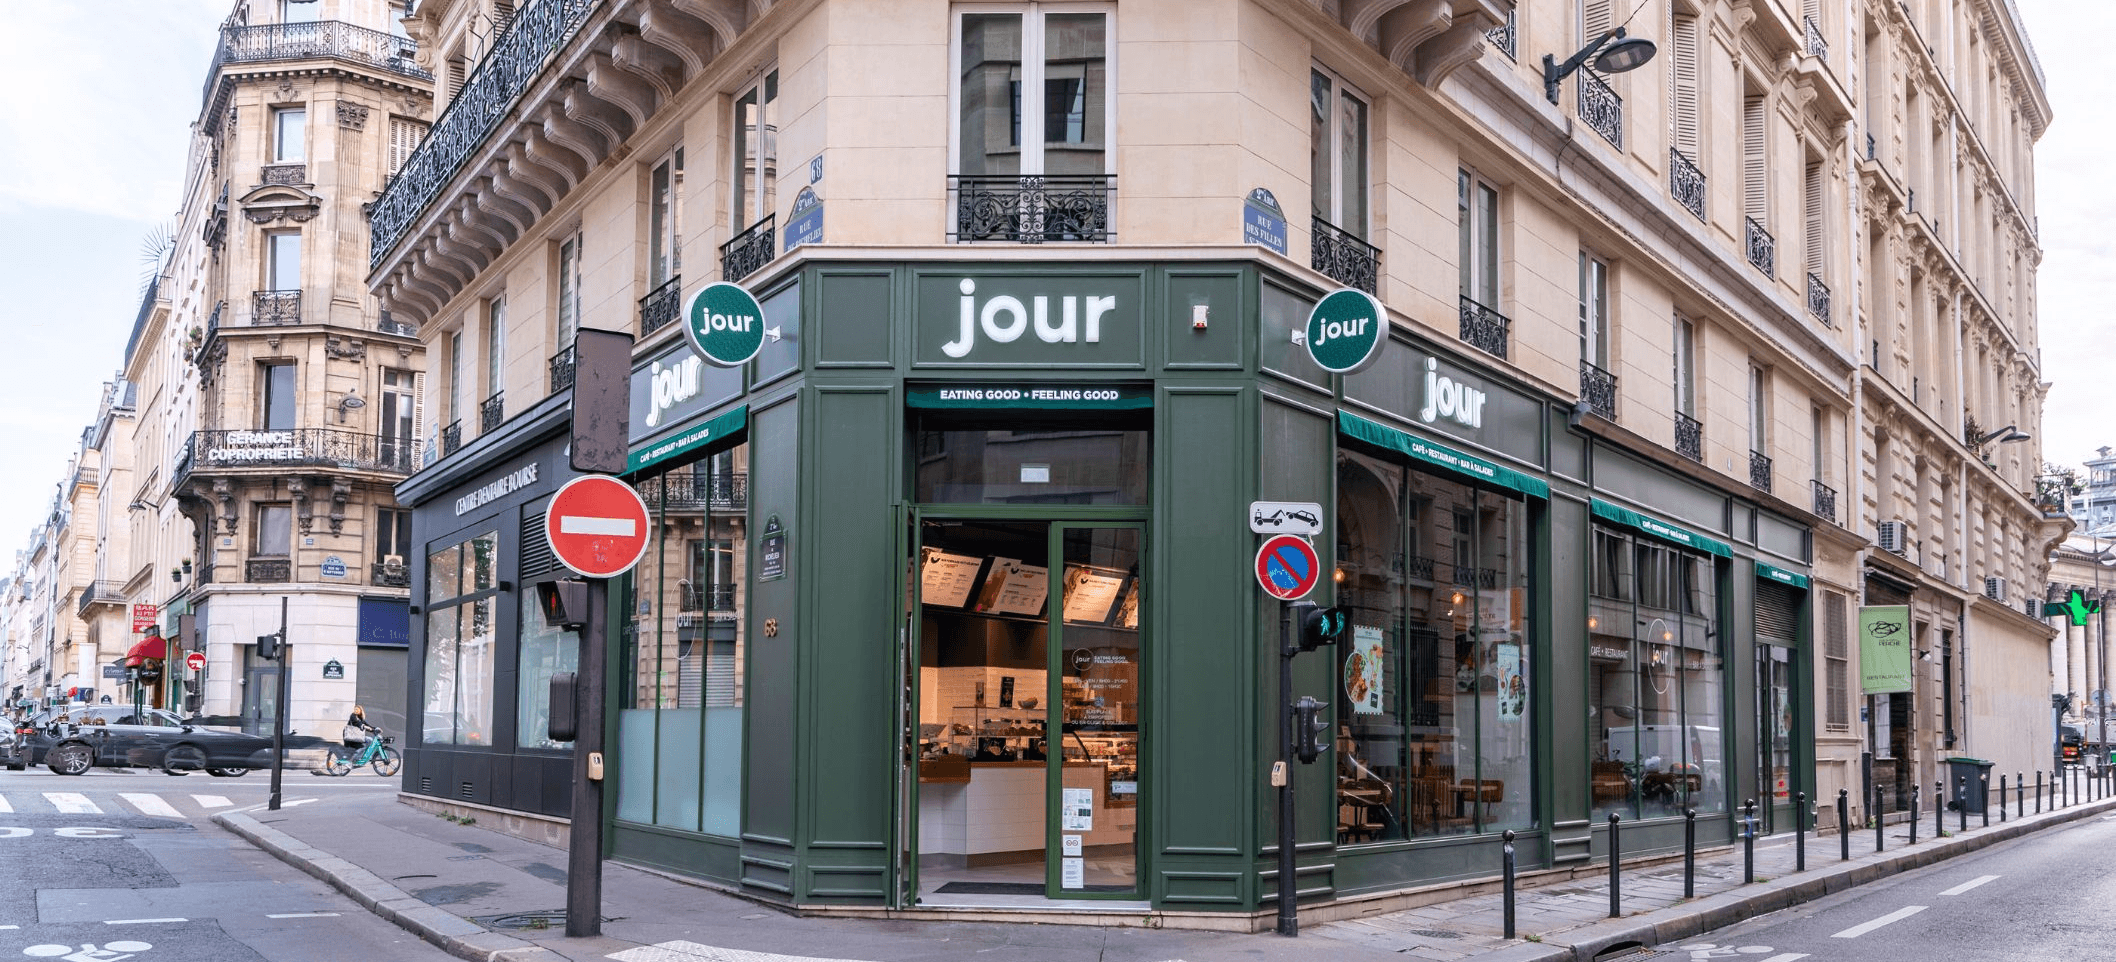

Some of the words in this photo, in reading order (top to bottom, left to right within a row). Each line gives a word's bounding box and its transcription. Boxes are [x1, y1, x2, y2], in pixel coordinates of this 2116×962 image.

[812, 158, 822, 182] 68
[800, 219, 812, 234] RUE
[1246, 222, 1259, 236] DES
[1260, 229, 1282, 248] FILLES
[1258, 214, 1272, 230] RUE
[699, 307, 754, 335] jour
[940, 278, 1116, 358] jour
[1315, 317, 1369, 346] jour
[645, 354, 702, 428] jour
[940, 389, 983, 400] EATING
[986, 389, 1021, 400] GOOD
[1032, 389, 1081, 400] FEELING
[1083, 389, 1119, 400] GOOD
[1421, 356, 1486, 428] jour
[226, 430, 292, 444] GÉRANCE
[640, 451, 650, 463] CAFÉ
[652, 442, 676, 458] RESTAURANT
[678, 437, 686, 448] BAR
[690, 428, 709, 442] SALADES
[1412, 442, 1425, 454] CAFÉ
[1428, 448, 1458, 466] RESTAURANT
[1460, 459, 1470, 470] BAR
[1474, 462, 1494, 477] SALADES
[456, 491, 478, 516] CENTRE
[478, 476, 508, 506] DENTAIRE
[508, 462, 538, 492] BOURSE
[1076, 656, 1090, 664] jour
